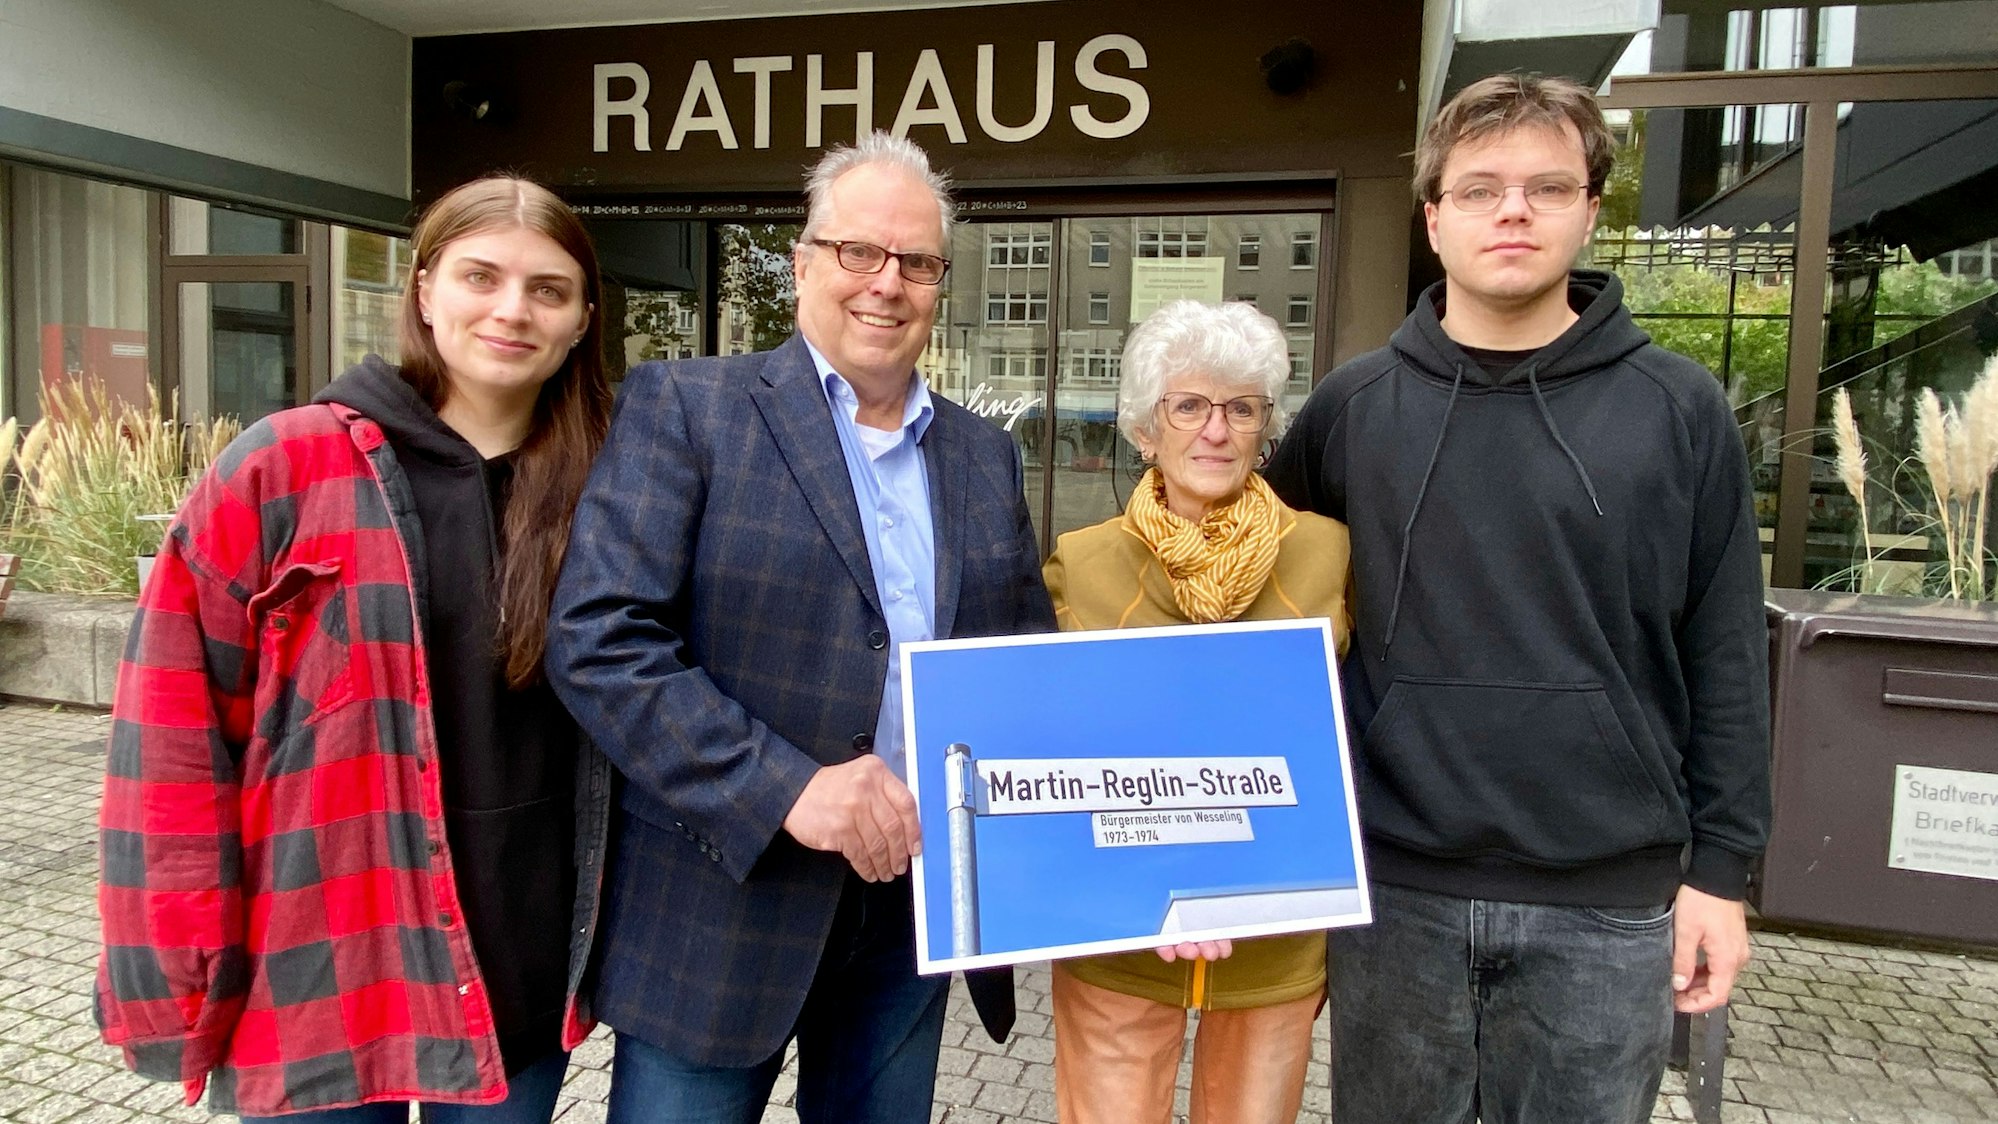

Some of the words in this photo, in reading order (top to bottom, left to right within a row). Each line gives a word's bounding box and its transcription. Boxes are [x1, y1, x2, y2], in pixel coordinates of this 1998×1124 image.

[593, 34, 1150, 152] RATHAUS
[990, 767, 1284, 805] Martin-Reglin-Straße
[1100, 813, 1173, 829] Bürgermeister
[1176, 814, 1193, 825] von
[1195, 810, 1244, 825] Wesseling
[1103, 830, 1160, 844] 1973-1974
